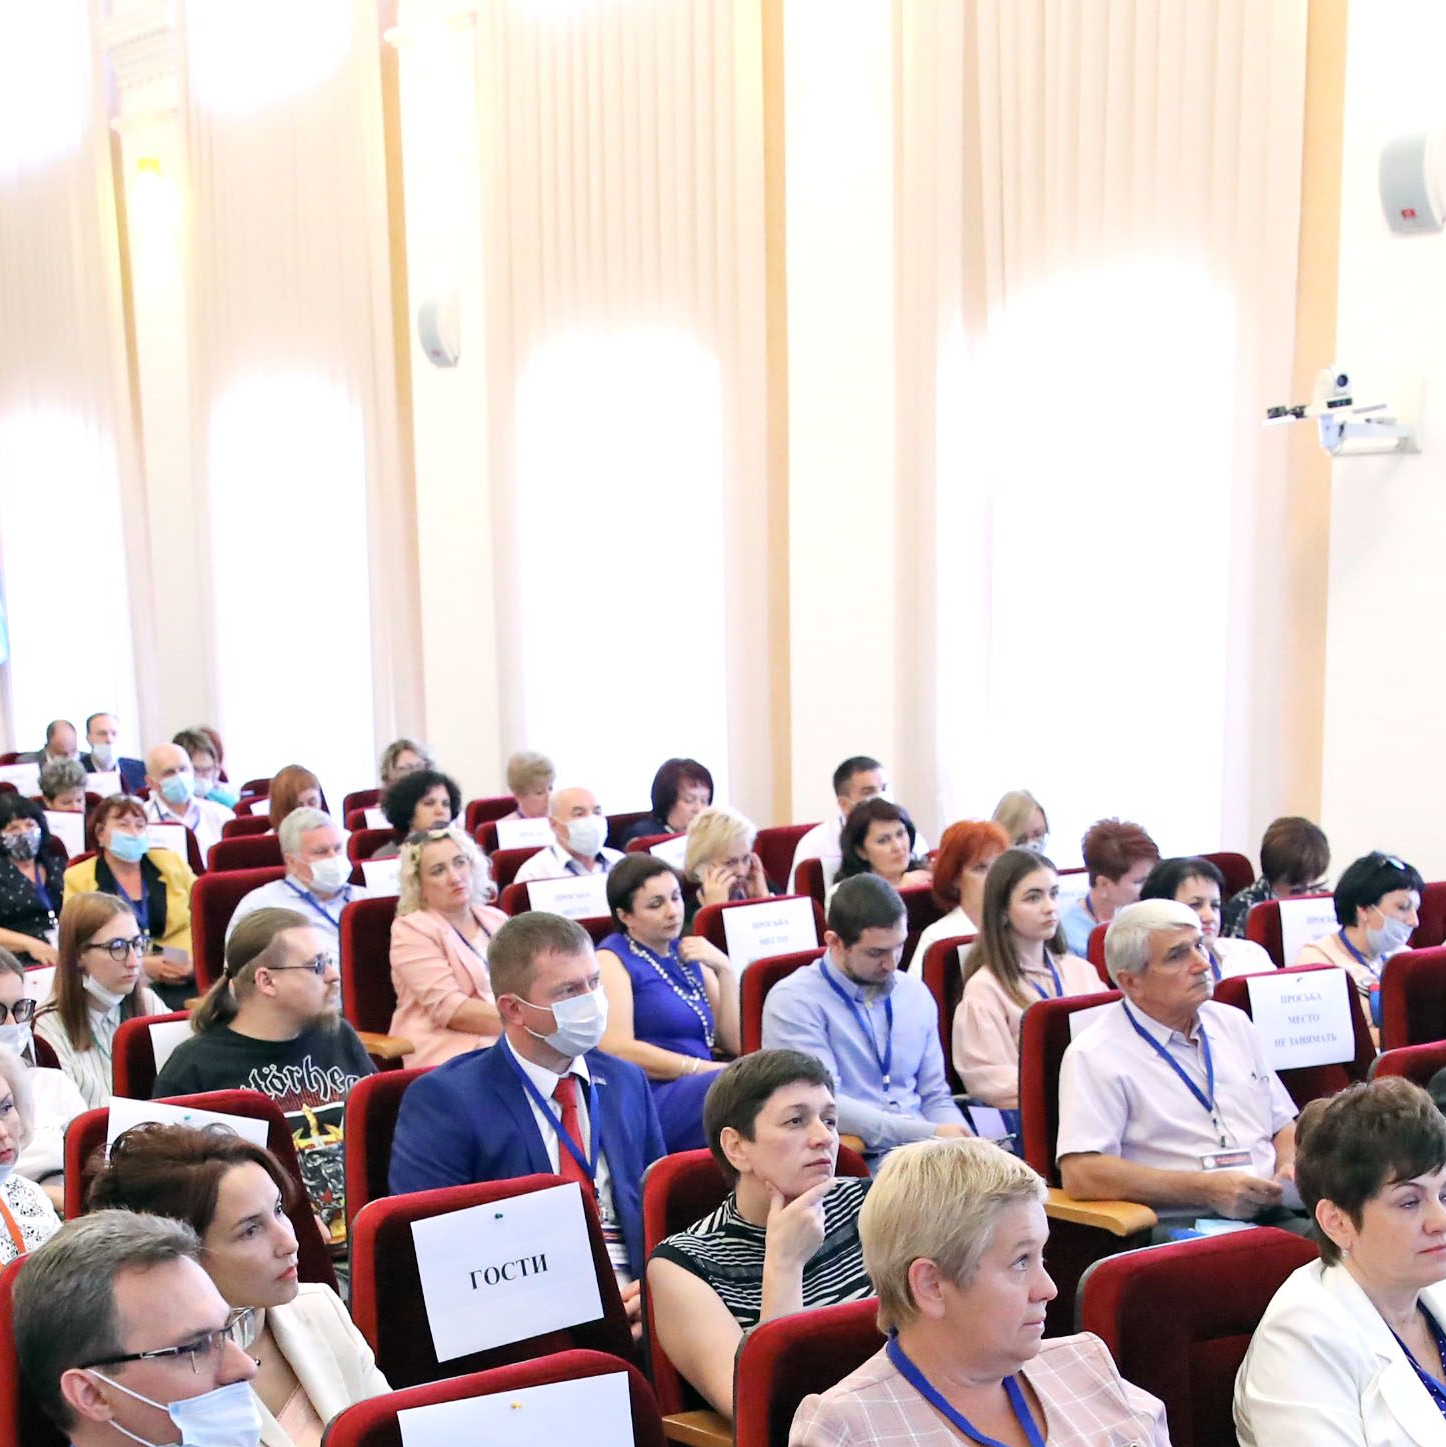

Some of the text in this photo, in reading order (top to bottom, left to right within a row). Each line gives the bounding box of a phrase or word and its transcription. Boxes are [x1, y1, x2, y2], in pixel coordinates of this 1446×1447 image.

[1280, 992, 1322, 1005] ПРОСЬБА
[1287, 1013, 1320, 1025] МЕСТО
[1274, 1033, 1338, 1048] НЕ ЗАНИМАТЬ
[469, 1253, 549, 1291] ГОСТИ
